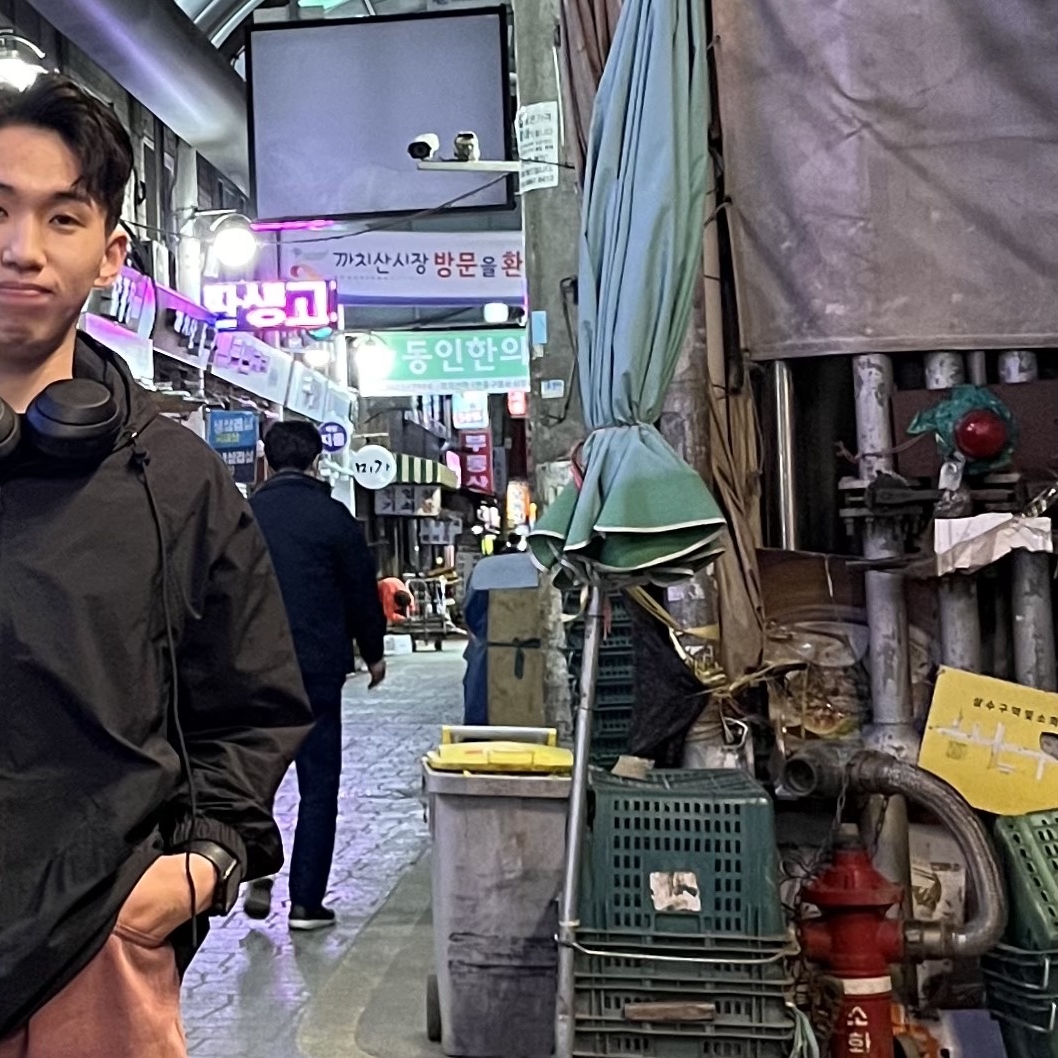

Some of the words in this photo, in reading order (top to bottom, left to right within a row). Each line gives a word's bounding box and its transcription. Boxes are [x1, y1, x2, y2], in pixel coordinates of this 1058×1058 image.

[333, 252, 429, 275] 까치산시장
[434, 251, 498, 278] 방문을
[402, 336, 527, 375] 동인한의
